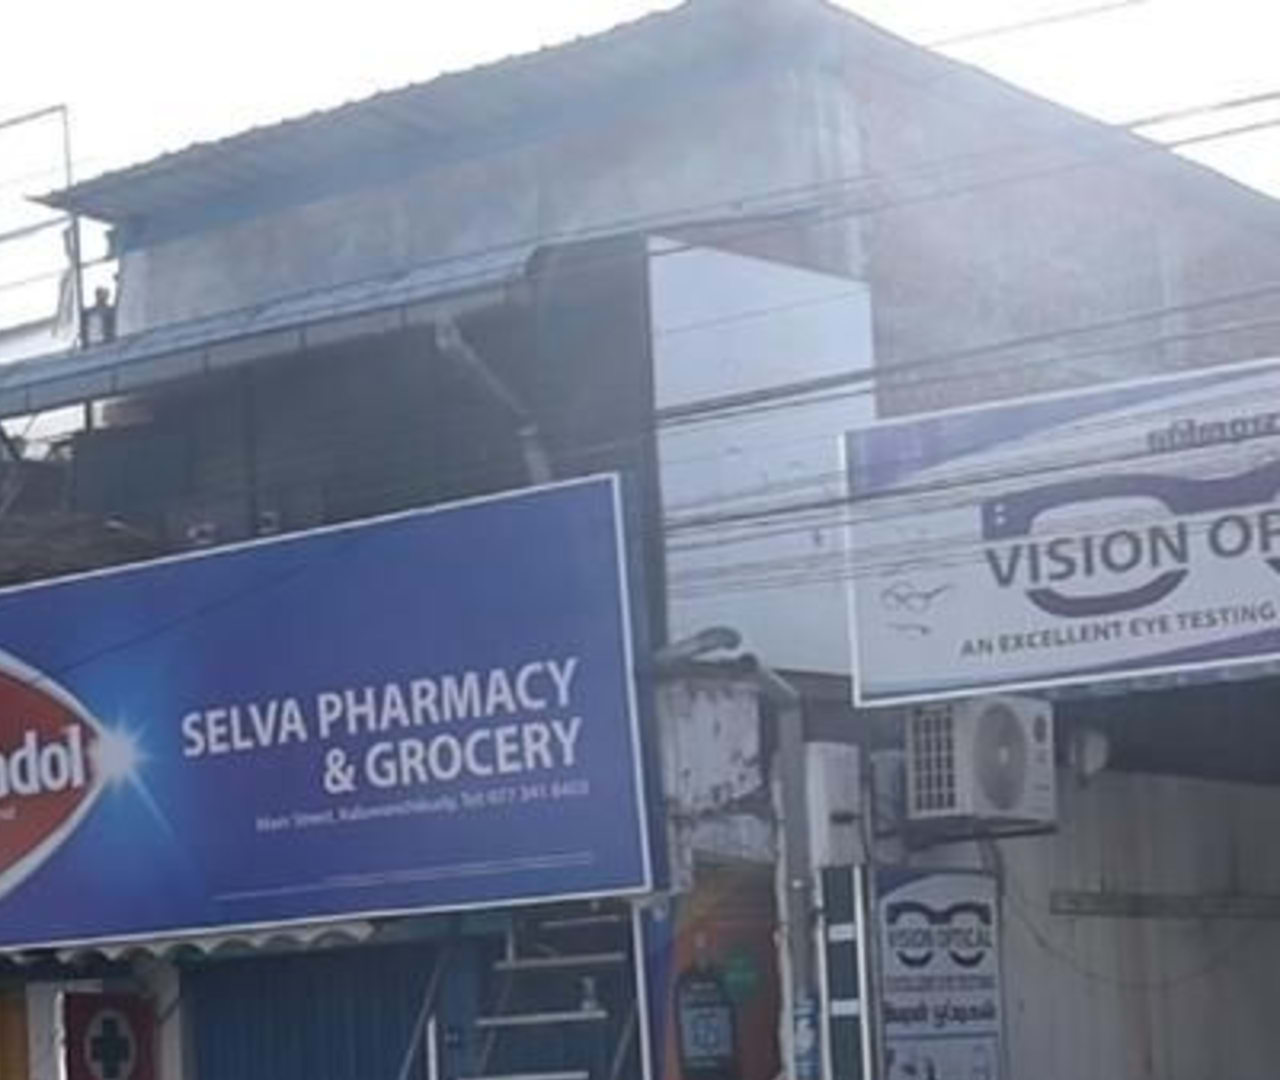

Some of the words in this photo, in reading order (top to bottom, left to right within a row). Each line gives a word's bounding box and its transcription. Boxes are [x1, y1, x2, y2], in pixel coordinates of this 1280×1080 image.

[985, 521, 1190, 588] VISION
[960, 637, 994, 657] AN
[998, 620, 1123, 655] EXCELLENT
[1130, 613, 1169, 638] EYE
[1176, 600, 1277, 632] TESTING
[181, 699, 307, 758] SELVA
[317, 656, 578, 740] PHARMACY
[323, 747, 356, 795] &
[364, 716, 583, 789] GROCERY
